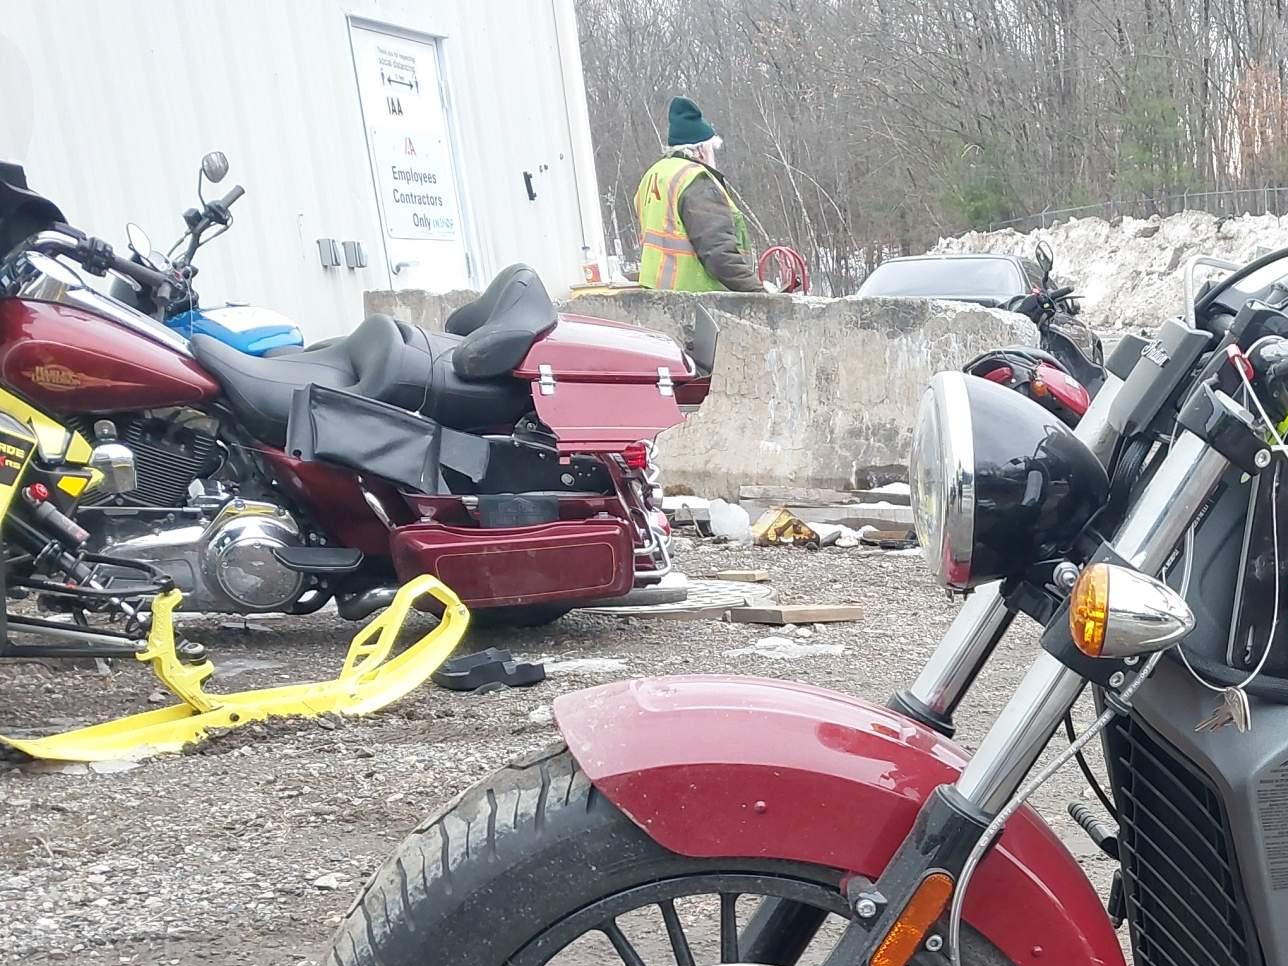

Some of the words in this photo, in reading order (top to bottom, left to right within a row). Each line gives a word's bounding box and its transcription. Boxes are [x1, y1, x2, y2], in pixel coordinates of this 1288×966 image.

[386, 96, 403, 116] IAA
[391, 165, 437, 186] Employees
[392, 188, 443, 207] Contractors
[412, 212, 431, 231] Only
